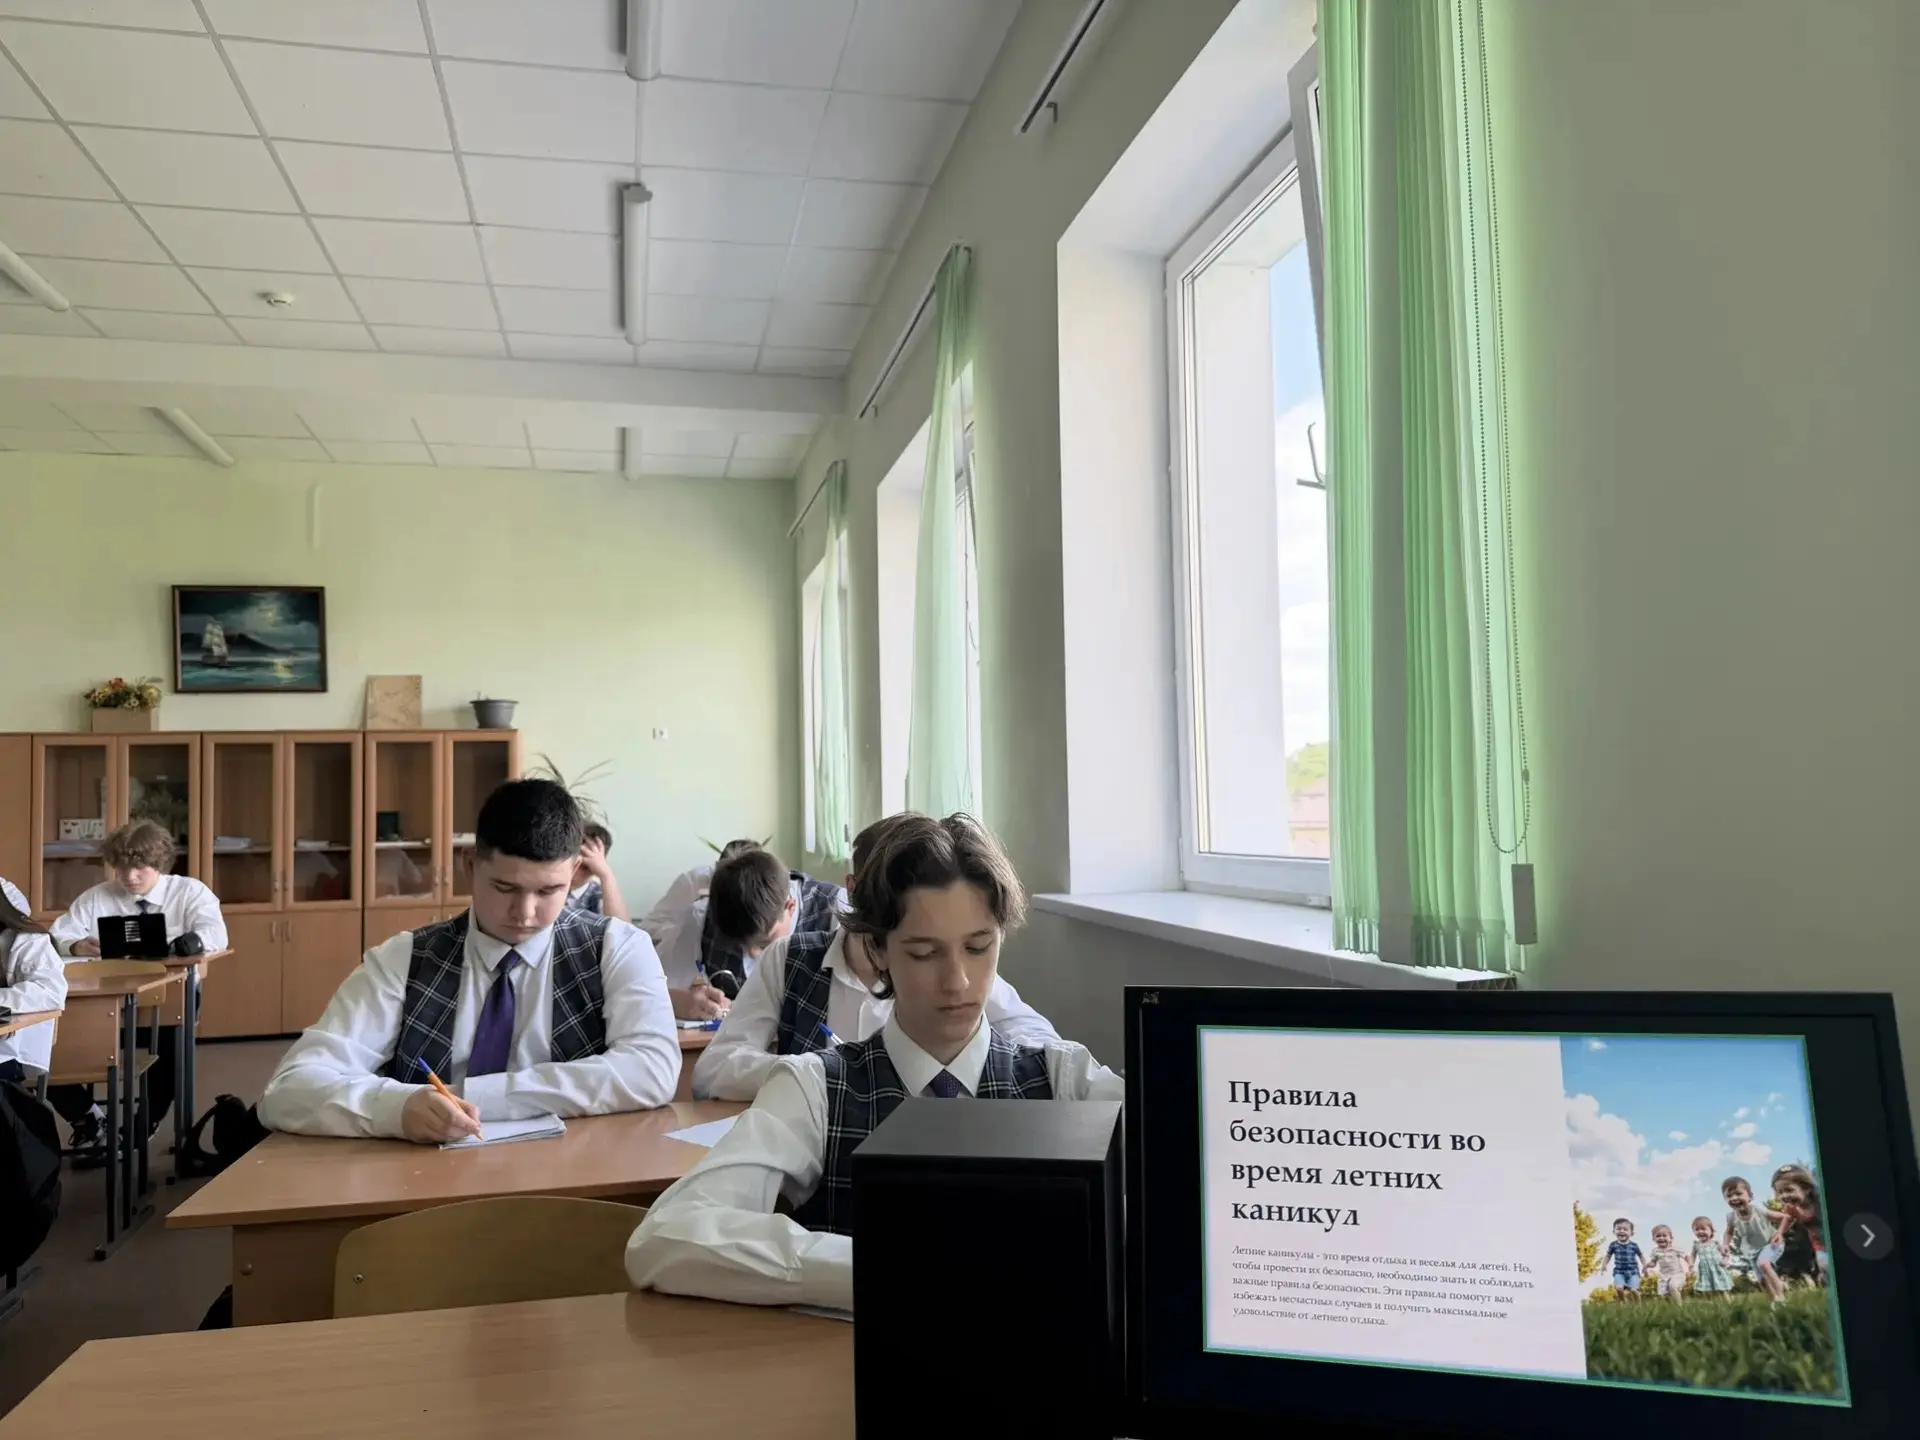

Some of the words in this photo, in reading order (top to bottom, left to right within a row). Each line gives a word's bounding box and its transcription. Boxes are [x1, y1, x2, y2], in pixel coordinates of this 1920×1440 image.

[1228, 1081, 1358, 1111] Правила
[1230, 1120, 1441, 1150] безопасности
[1451, 1133, 1486, 1152] во
[1231, 1163, 1322, 1188] время
[1331, 1169, 1443, 1189] летних
[1232, 1202, 1359, 1232] каникул
[1232, 1246, 1265, 1256] Летние
[1268, 1250, 1313, 1260] каникулы
[1323, 1253, 1338, 1261] это
[1341, 1255, 1370, 1264] время
[1372, 1256, 1407, 1266] отдыха
[1419, 1259, 1455, 1268] веселья
[1479, 1262, 1511, 1272] детей.
[1514, 1263, 1531, 1273] Но,
[1233, 1261, 1260, 1270] чтобы
[1264, 1264, 1306, 1274] провести
[1323, 1267, 1374, 1279] безопасно,
[1377, 1270, 1438, 1283] необходимо
[1440, 1275, 1467, 1284] знать
[1479, 1277, 1534, 1289] соблюдать
[1233, 1277, 1268, 1287] важные
[1271, 1280, 1310, 1290] правила
[1313, 1281, 1381, 1295] безопасности.
[1383, 1286, 1402, 1296] Эти
[1405, 1289, 1446, 1299] правила
[1450, 1292, 1491, 1304] помогут
[1233, 1292, 1277, 1302] избежать
[1280, 1295, 1333, 1306] несчастных
[1335, 1300, 1372, 1310] случаев
[1384, 1303, 1431, 1315] получить
[1434, 1307, 1507, 1318] максимальное
[1233, 1306, 1296, 1318] удовольствие
[1311, 1313, 1348, 1323] летнего
[1350, 1316, 1388, 1326] отдыха.
